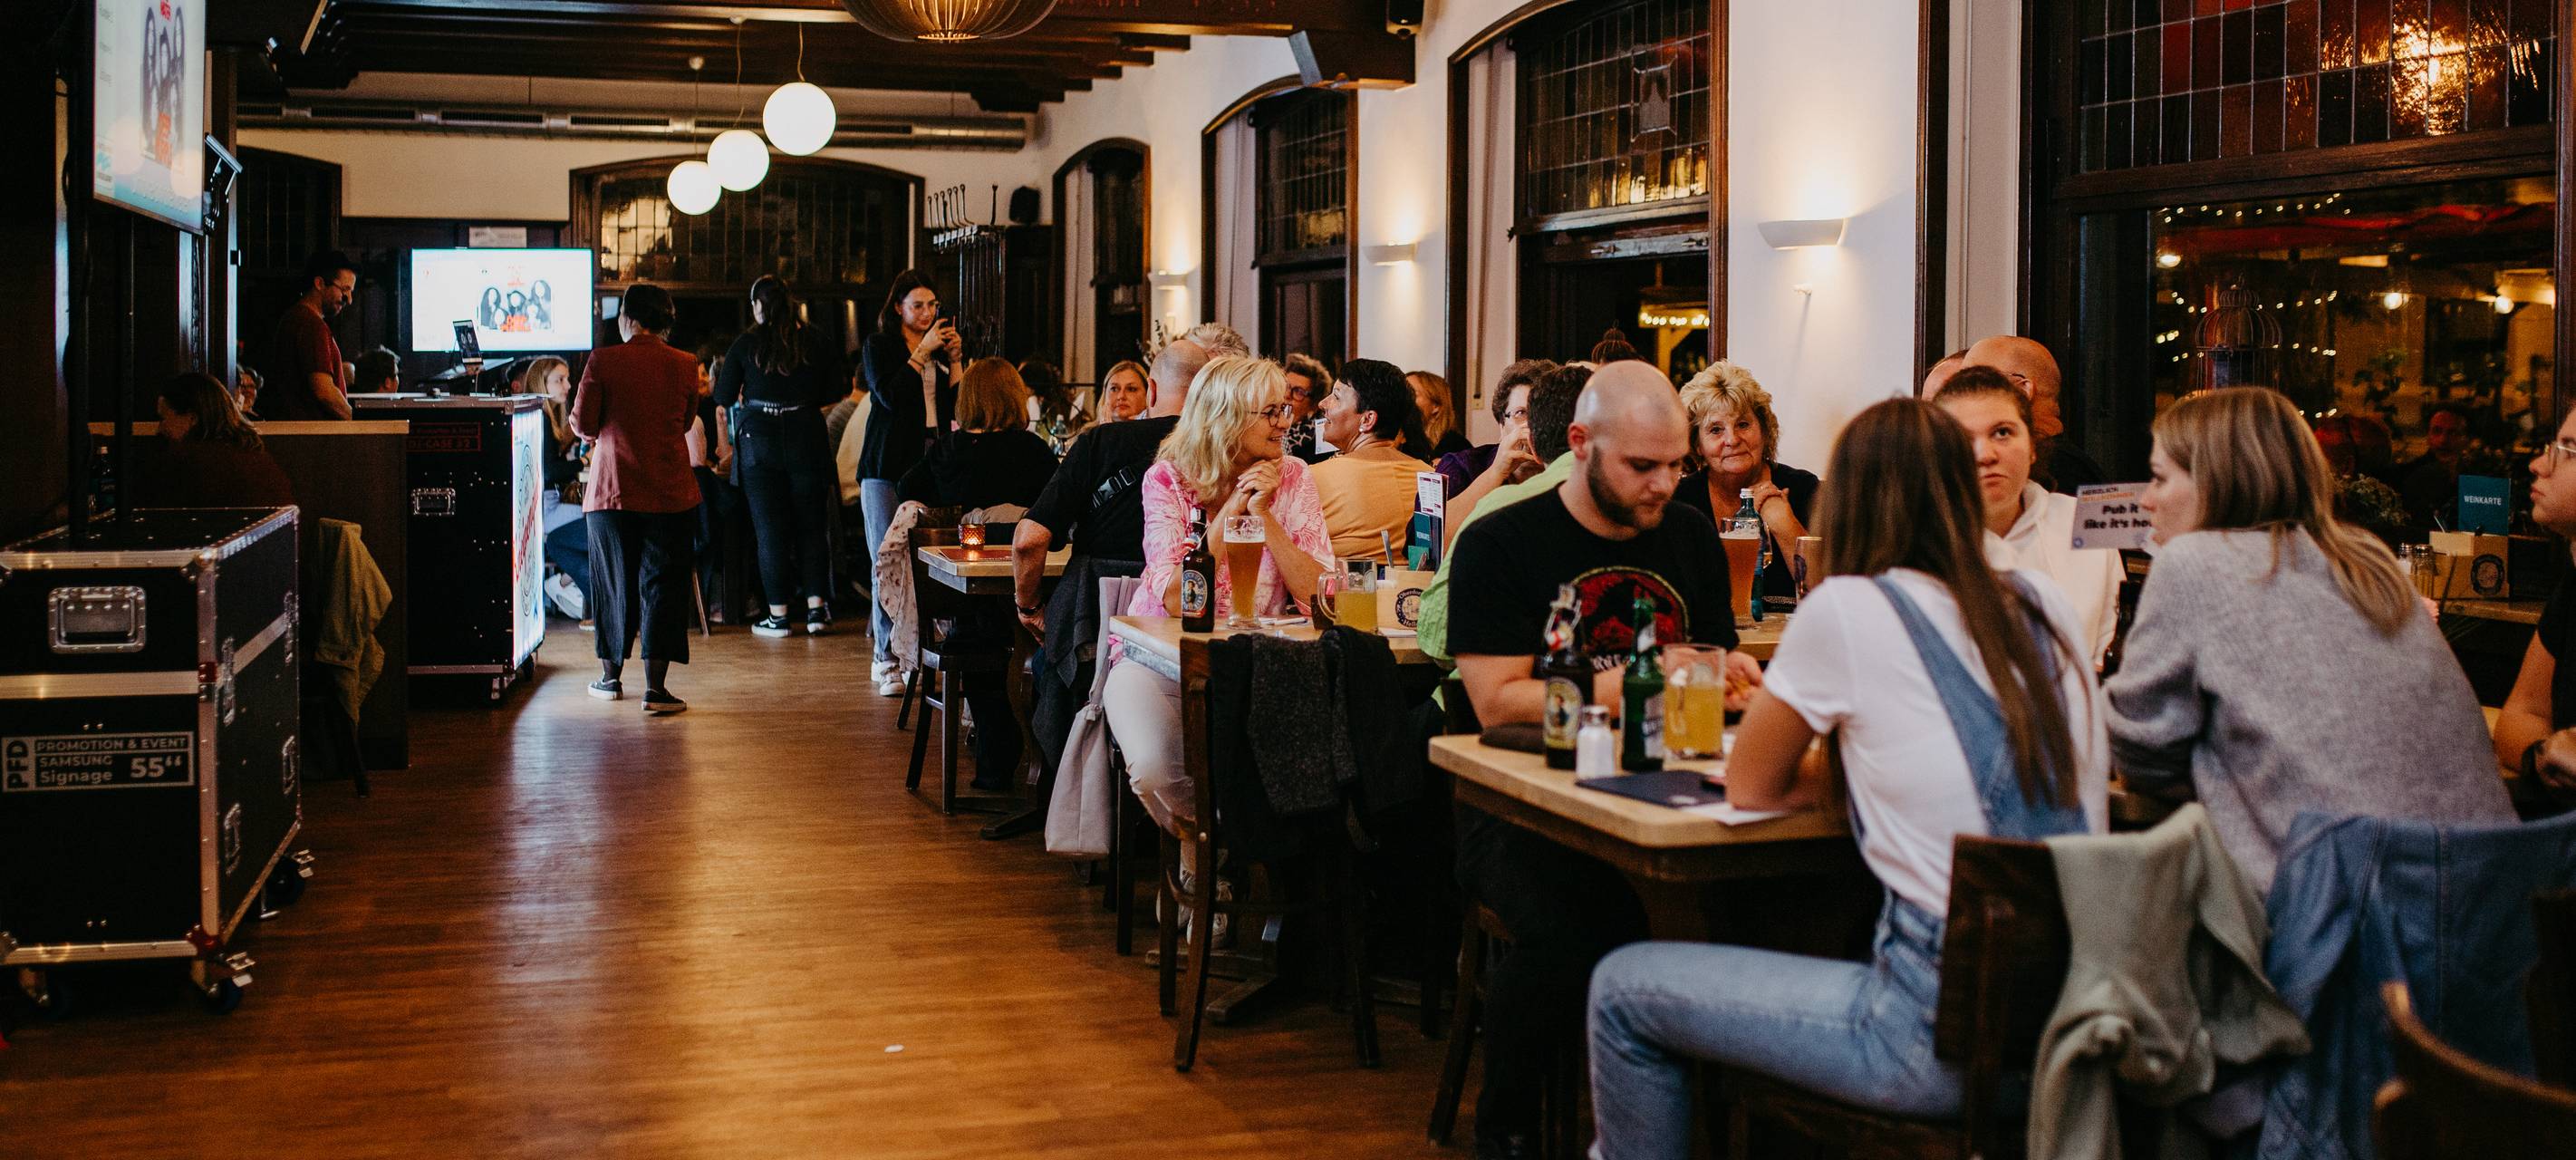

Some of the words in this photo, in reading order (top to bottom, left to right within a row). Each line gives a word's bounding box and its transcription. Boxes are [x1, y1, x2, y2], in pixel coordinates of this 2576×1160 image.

[2464, 495, 2502, 506] WEINKARTE
[2102, 505, 2127, 515] Pub
[2130, 503, 2138, 514] it
[2084, 518, 2107, 529] like
[2109, 518, 2128, 528] it's
[36, 739, 123, 751] PROMOTION
[128, 739, 137, 749] &
[141, 737, 186, 749] EVENT
[39, 755, 113, 768] SAMSUNG
[39, 769, 113, 785] Signage
